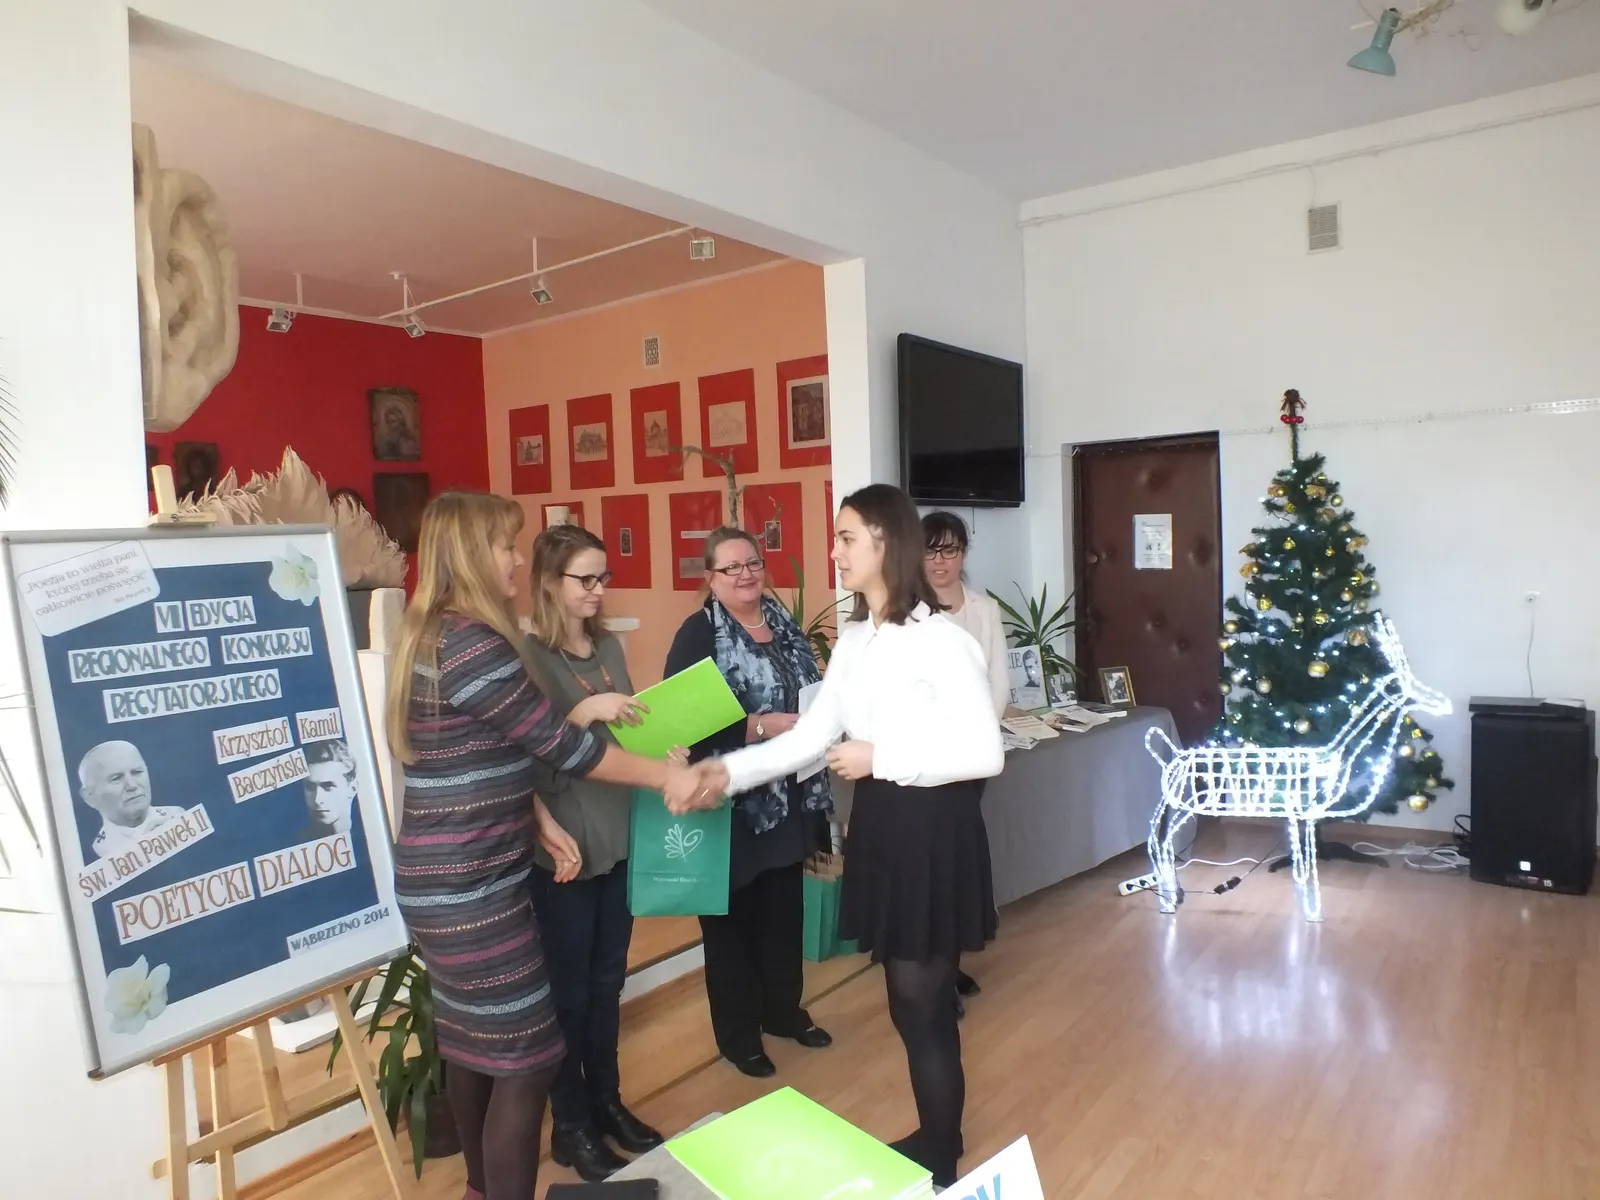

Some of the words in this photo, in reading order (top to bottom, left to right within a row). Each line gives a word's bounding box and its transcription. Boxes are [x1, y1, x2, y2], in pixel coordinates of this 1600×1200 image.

[66, 569, 80, 578] to
[81, 558, 114, 574] wielka
[81, 571, 115, 587] trzeba
[189, 599, 254, 627] EDYCJA
[72, 640, 207, 680] REGIONALNEGO
[223, 630, 310, 661] KONKURSU
[110, 673, 280, 719] RECYTATORSKIEGO
[217, 719, 289, 757] Krzysztof
[299, 712, 340, 740] Kamil
[232, 751, 308, 798] Baczyński
[108, 851, 143, 881] Jan
[138, 815, 197, 864] Paweł
[192, 809, 210, 832] II
[116, 865, 252, 940] POETYCKI
[257, 835, 352, 892] DIALOG
[290, 918, 361, 951] WĄBRZEŹNO
[363, 907, 390, 925] 2014
